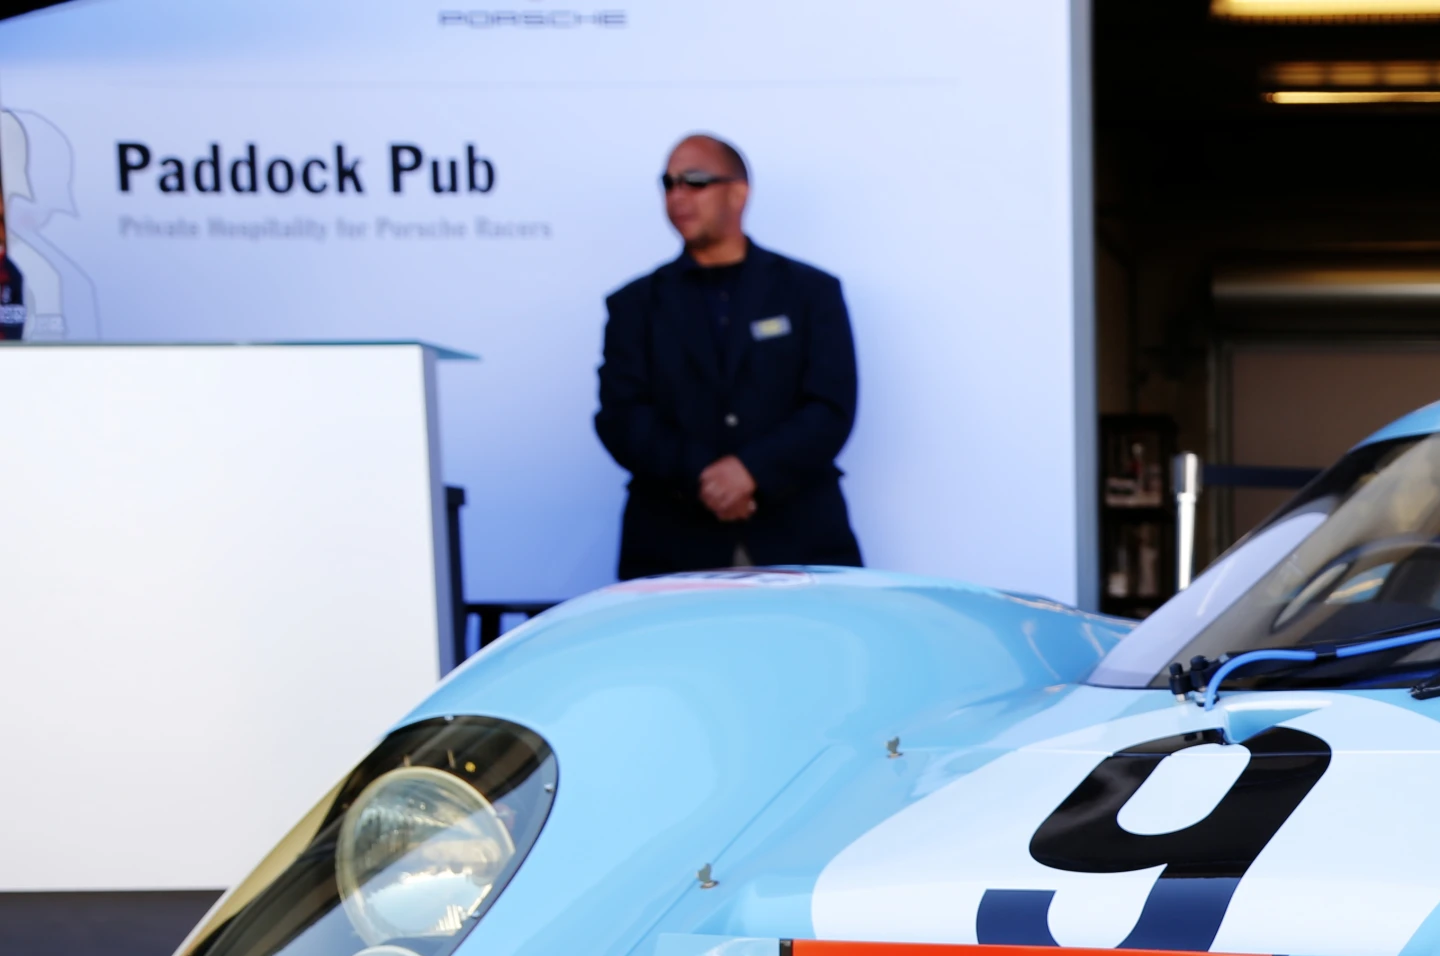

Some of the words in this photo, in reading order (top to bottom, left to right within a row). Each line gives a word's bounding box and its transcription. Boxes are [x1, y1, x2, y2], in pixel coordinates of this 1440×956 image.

[438, 9, 628, 29] PORSCHE
[116, 143, 364, 194] Paddock
[390, 144, 496, 194] Pub
[118, 216, 199, 239] Private
[206, 216, 326, 243] Hospitality
[335, 216, 368, 238] for
[375, 216, 467, 239] Porsche
[976, 725, 1332, 952] 9
